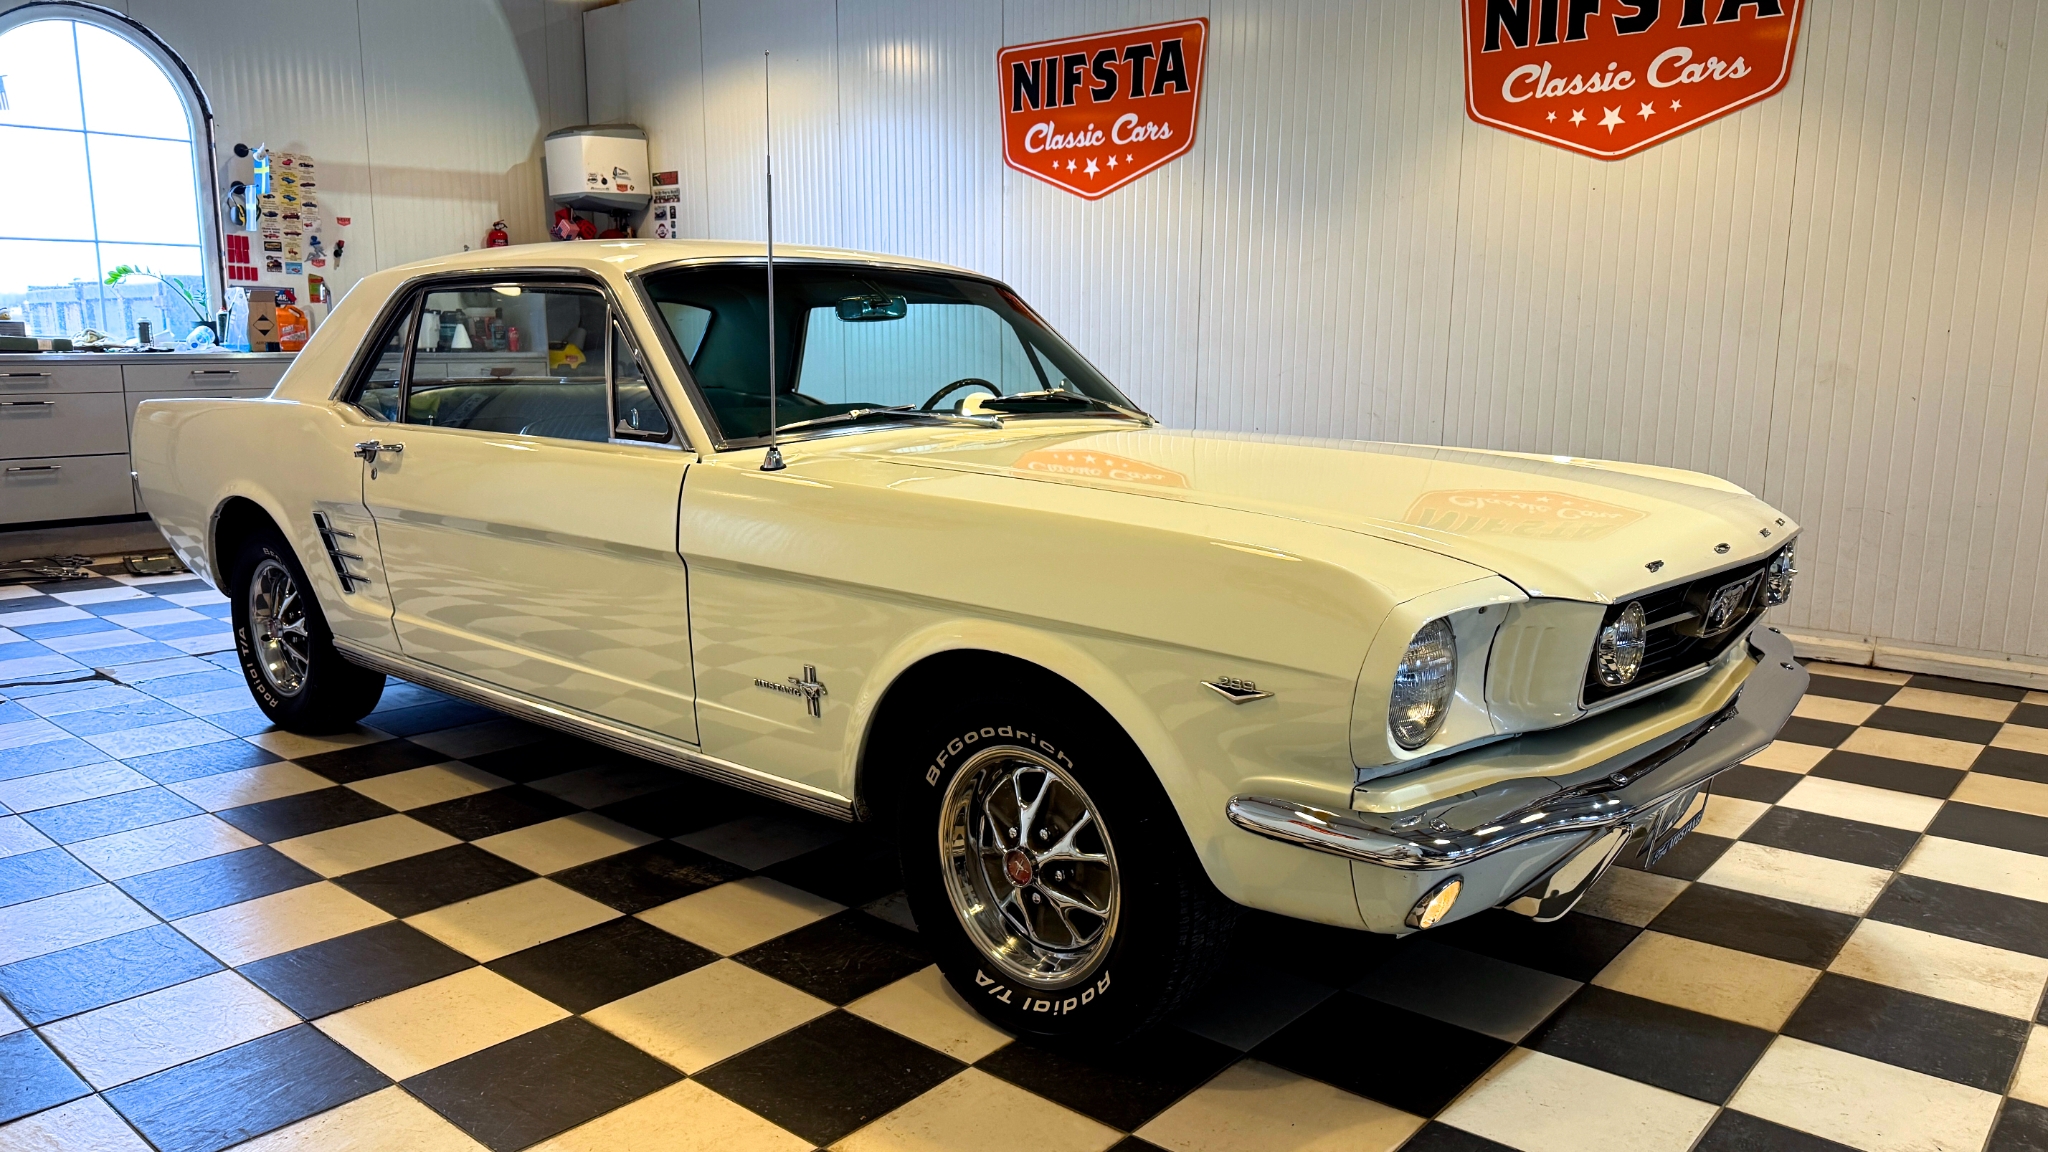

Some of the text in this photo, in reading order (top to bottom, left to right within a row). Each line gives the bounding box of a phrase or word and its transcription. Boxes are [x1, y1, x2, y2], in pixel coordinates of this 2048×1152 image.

[1481, 0, 1785, 53] NIF
[1011, 38, 1191, 113] NIFSTA
[1502, 46, 1752, 103] Classic Cars
[1024, 112, 1174, 154] Classic Cars
[238, 626, 279, 708] Radial T/A
[753, 677, 802, 697] MUSTANG
[1218, 675, 1256, 692] 289
[925, 725, 1074, 788] BFGoodrich
[974, 969, 1111, 1016] Radial T/A
